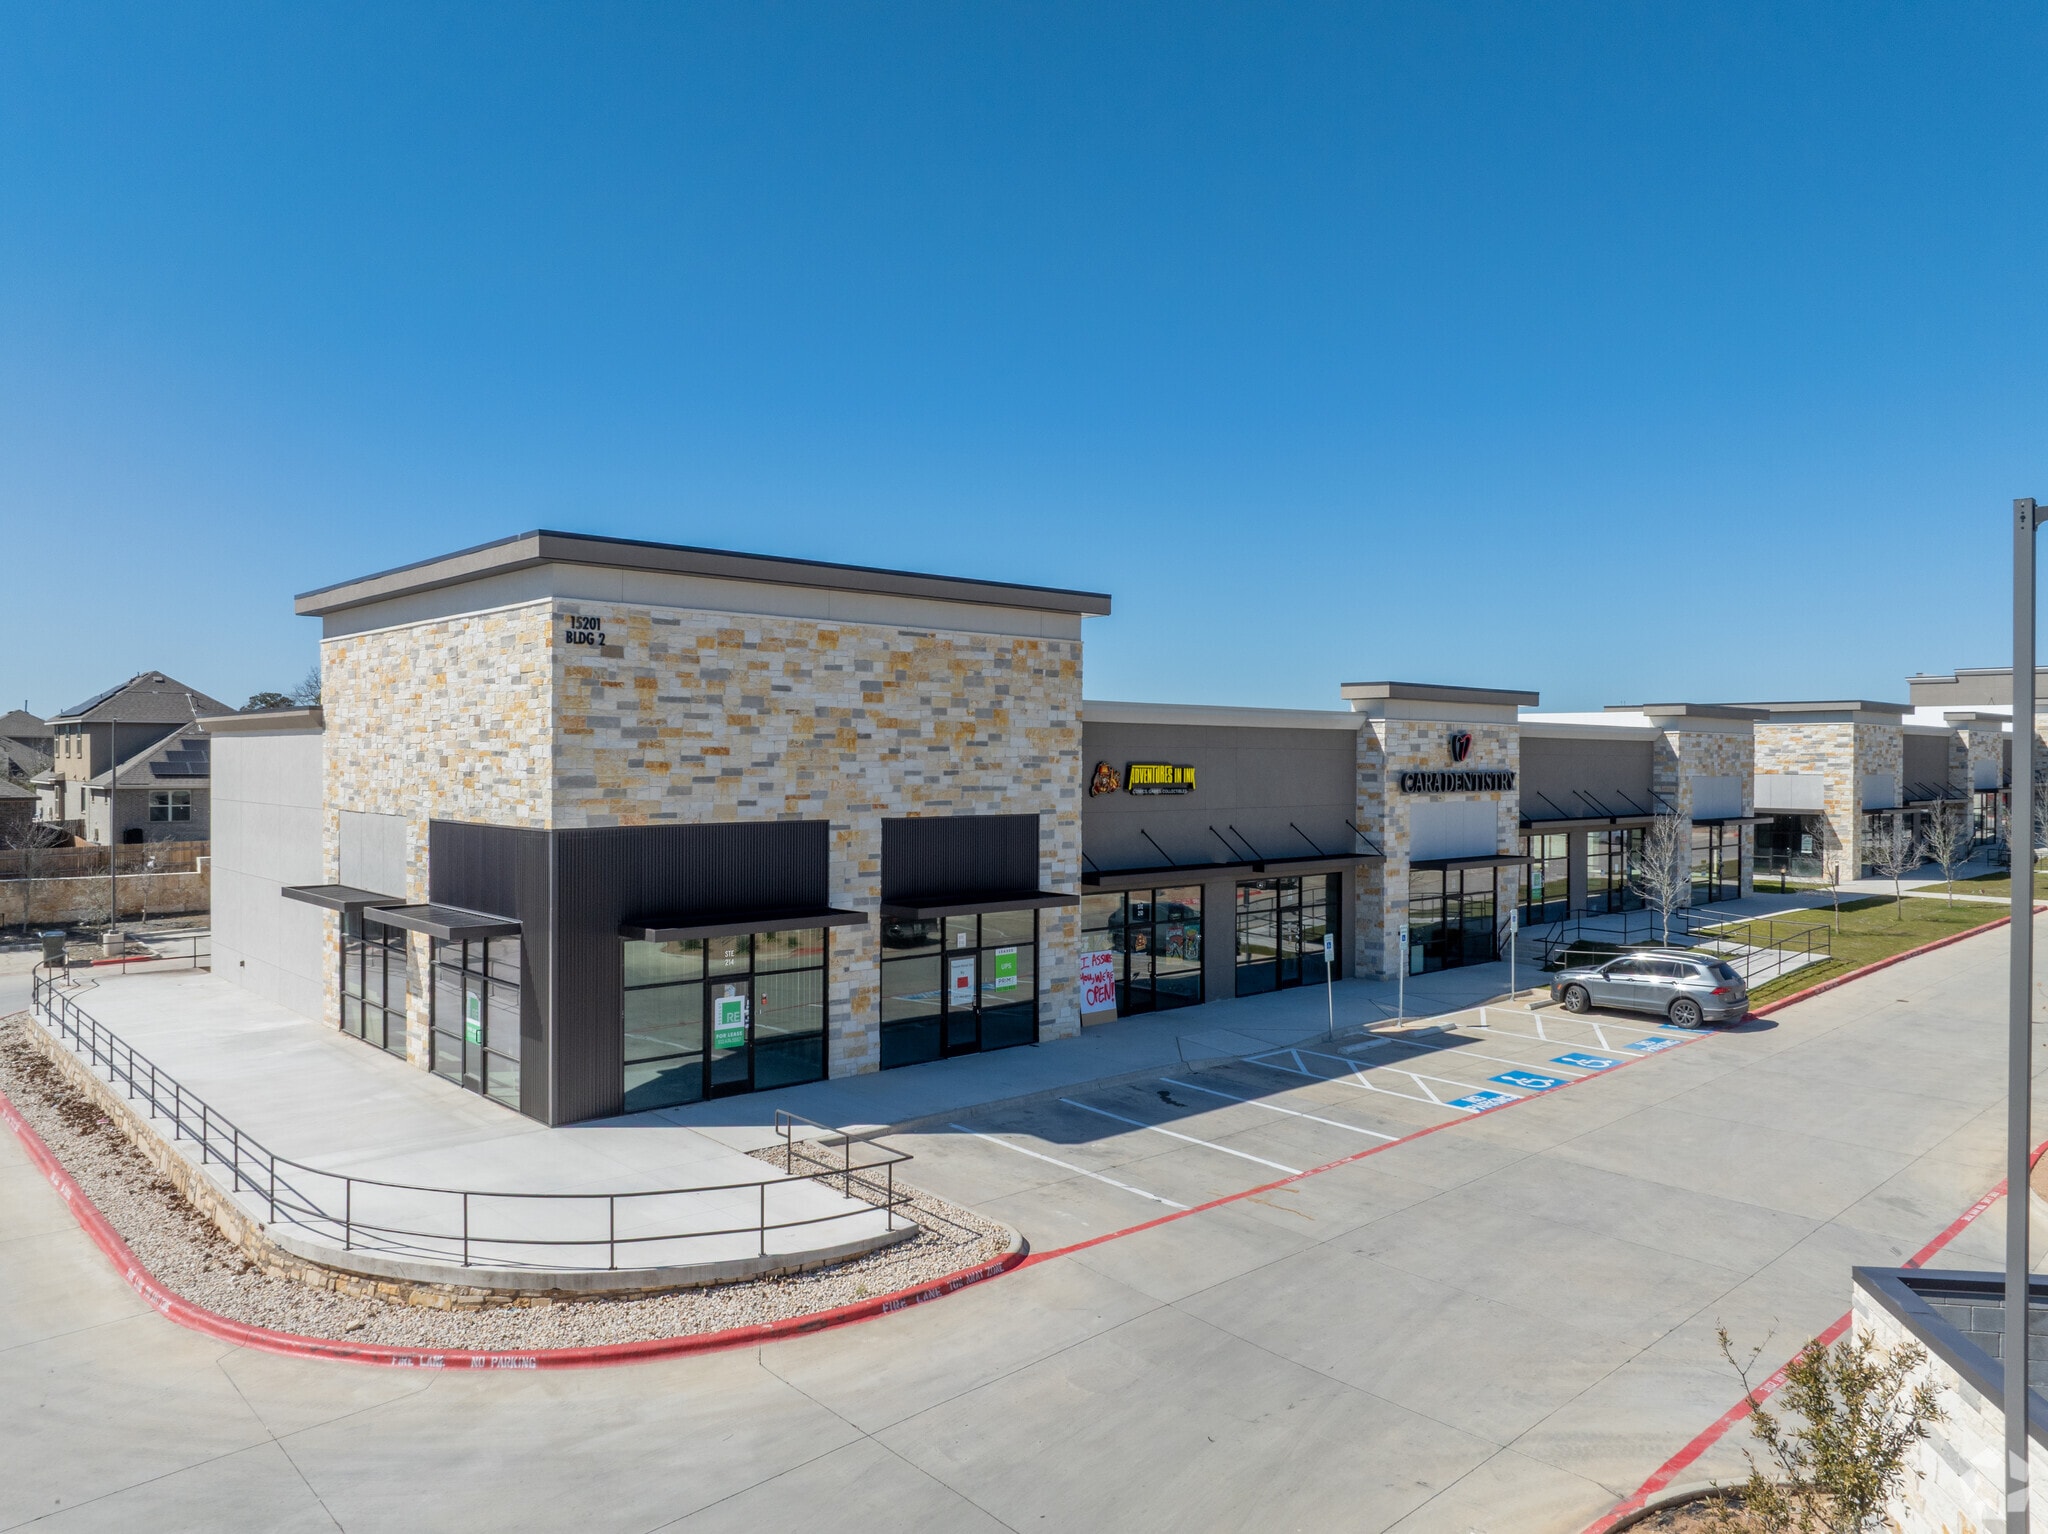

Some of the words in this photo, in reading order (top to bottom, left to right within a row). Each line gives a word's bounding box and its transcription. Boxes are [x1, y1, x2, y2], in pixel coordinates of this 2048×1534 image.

[570, 615, 601, 630] 15201
[565, 631, 595, 645] BLDG
[598, 632, 606, 646] 2
[1128, 764, 1173, 790] ADVENTURES
[1174, 767, 1182, 783] IN
[1183, 767, 1196, 790] INK
[724, 950, 735, 958] STE
[1086, 981, 1115, 1006] OPEN!
[726, 1011, 741, 1023] RE
[727, 1030, 743, 1038] LEASE
[882, 1299, 908, 1313] FIRE
[916, 1287, 943, 1304] LANE
[470, 1356, 485, 1368] NO
[491, 1356, 537, 1369] PARKING
